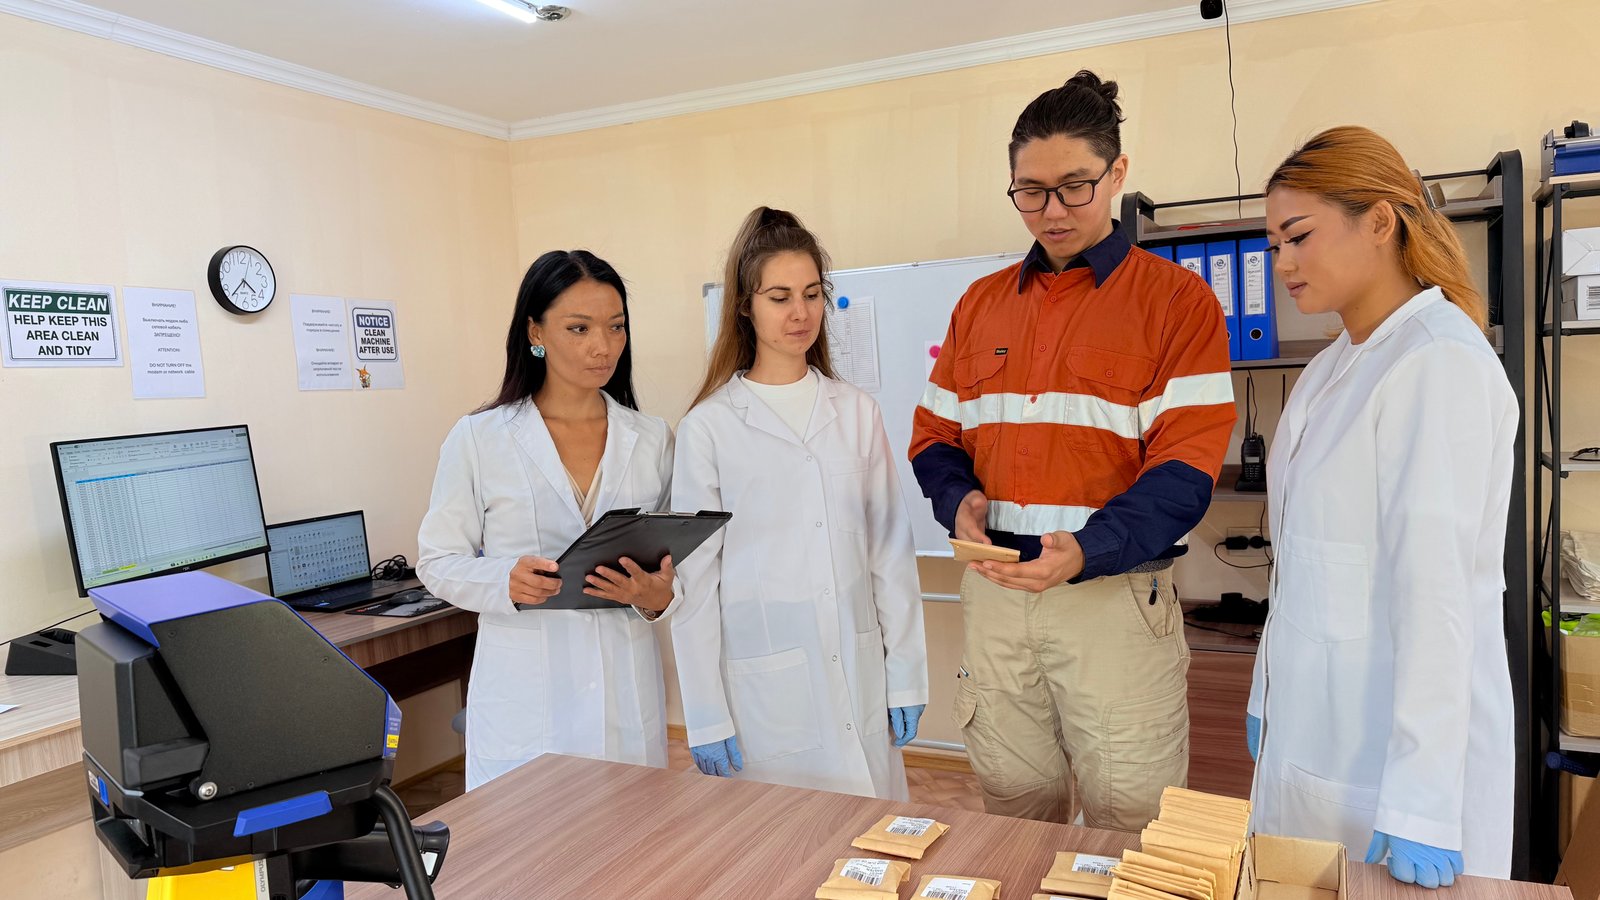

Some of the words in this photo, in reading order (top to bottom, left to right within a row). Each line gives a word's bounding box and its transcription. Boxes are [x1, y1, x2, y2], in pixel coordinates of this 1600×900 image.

[8, 293, 53, 309] KEEP
[56, 296, 107, 312] CLEAN
[14, 314, 46, 326] HELP
[48, 315, 79, 327] KEEP
[81, 316, 108, 327] THIS
[358, 316, 389, 327] NOTICE
[26, 330, 60, 341] AREA
[61, 331, 100, 341] CLEAN
[364, 329, 386, 337] CLEAN
[361, 338, 391, 346] MACHINE
[38, 345, 63, 356] AND
[65, 345, 92, 356] TIDY
[359, 346, 381, 354] AFTER
[258, 859, 266, 892] OLYMPUS
